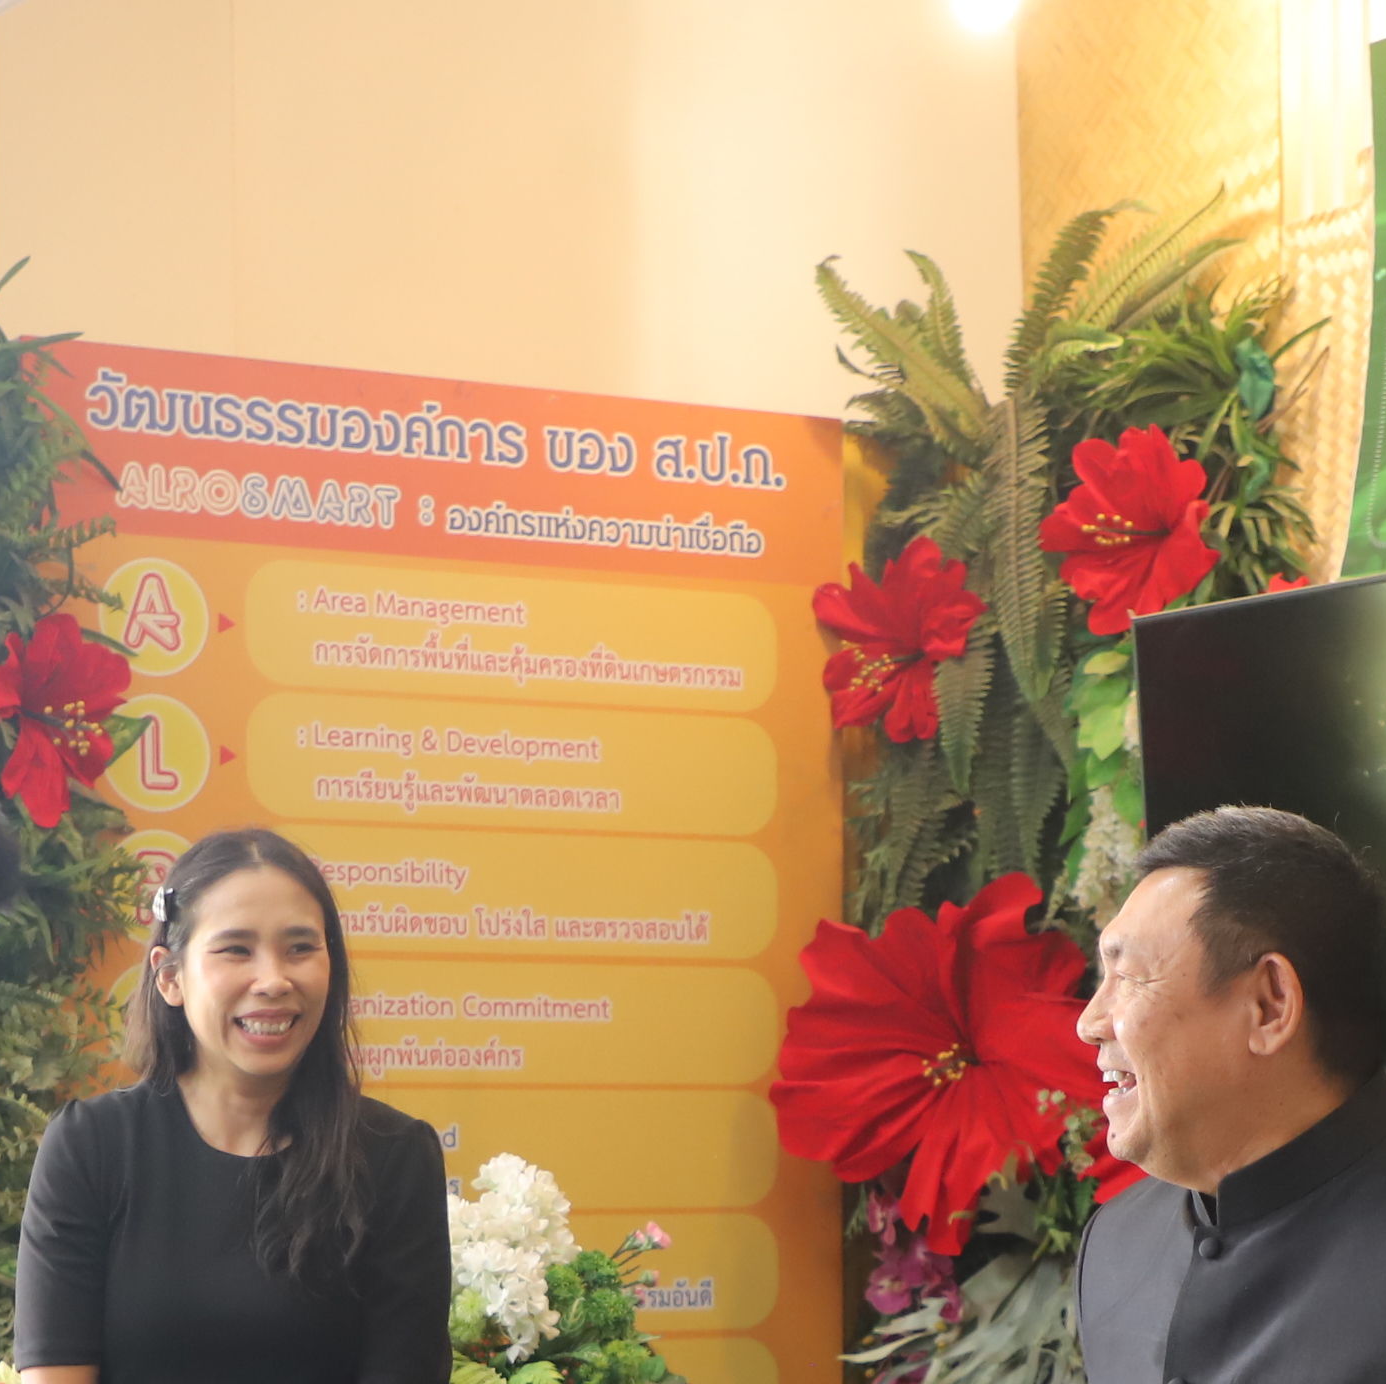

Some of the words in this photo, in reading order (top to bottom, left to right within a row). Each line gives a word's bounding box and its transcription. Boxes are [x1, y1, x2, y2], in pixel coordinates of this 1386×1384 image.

[86, 370, 526, 466] วัฒนธรรมองค์การ
[545, 428, 636, 474] ของ
[655, 431, 786, 489] ส.ป.ก.
[446, 502, 764, 555] องค์กรแห่งความน่าเชื่อถือ
[313, 588, 367, 613] Area
[375, 593, 525, 624] Management
[313, 723, 412, 755] Learning
[421, 729, 438, 752] &
[446, 729, 600, 761] Development
[316, 770, 620, 812] การเรียนรู้และพัฒนาตลอดเวลา
[311, 858, 466, 890] esponsibility
[339, 904, 468, 935] ามรับผิดชอบ
[474, 907, 547, 937] โปร่งใส
[554, 913, 709, 941] และตรวจสอบได้
[350, 994, 454, 1016] anization
[463, 995, 611, 1020] Commitment
[354, 1038, 522, 1076] มผูกพันต่อองค์กร
